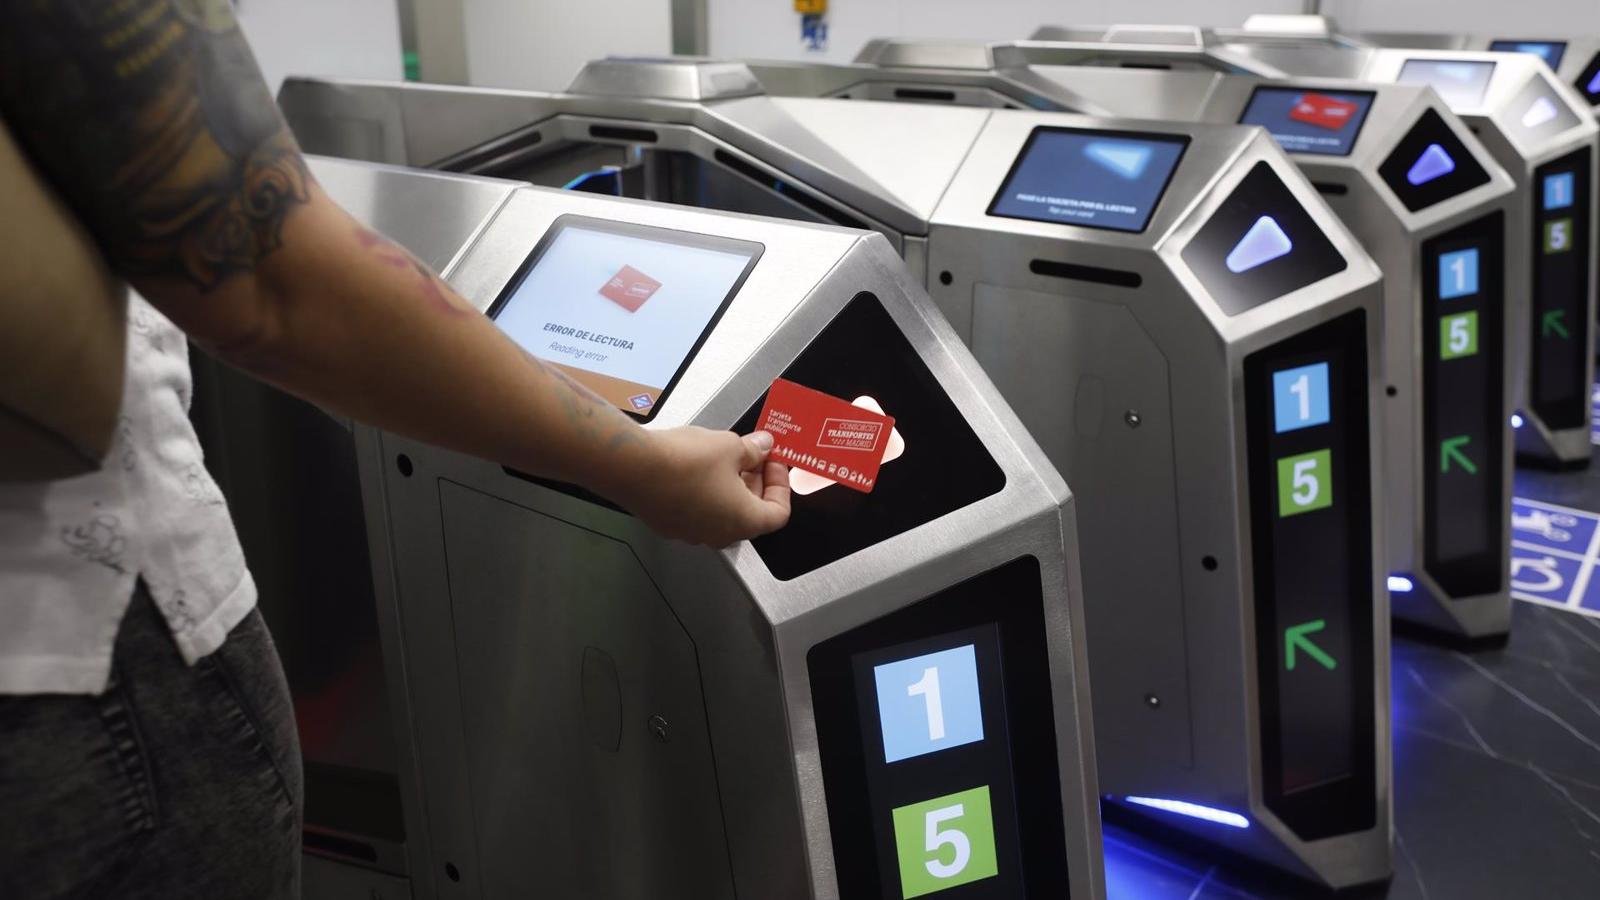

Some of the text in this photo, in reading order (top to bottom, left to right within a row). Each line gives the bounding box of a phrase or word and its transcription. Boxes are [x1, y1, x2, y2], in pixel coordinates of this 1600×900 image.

[1047, 196, 1079, 208] TARJETA
[1105, 204, 1137, 214] LECTOR
[1551, 221, 1567, 249] 5
[1451, 257, 1465, 291] 1
[543, 322, 634, 351] ERROR DE LECTURA
[1449, 317, 1469, 353] 5
[549, 341, 607, 361] Reading error
[1290, 374, 1310, 421] 1
[767, 415, 801, 432] transporte
[769, 409, 791, 422] tarjeta
[839, 422, 878, 432] CONSORCIO
[827, 429, 875, 440] TRANSPORTES
[846, 439, 872, 448] MADRID
[1292, 458, 1319, 505] 5
[907, 666, 945, 741] 1
[925, 803, 971, 878] 5
